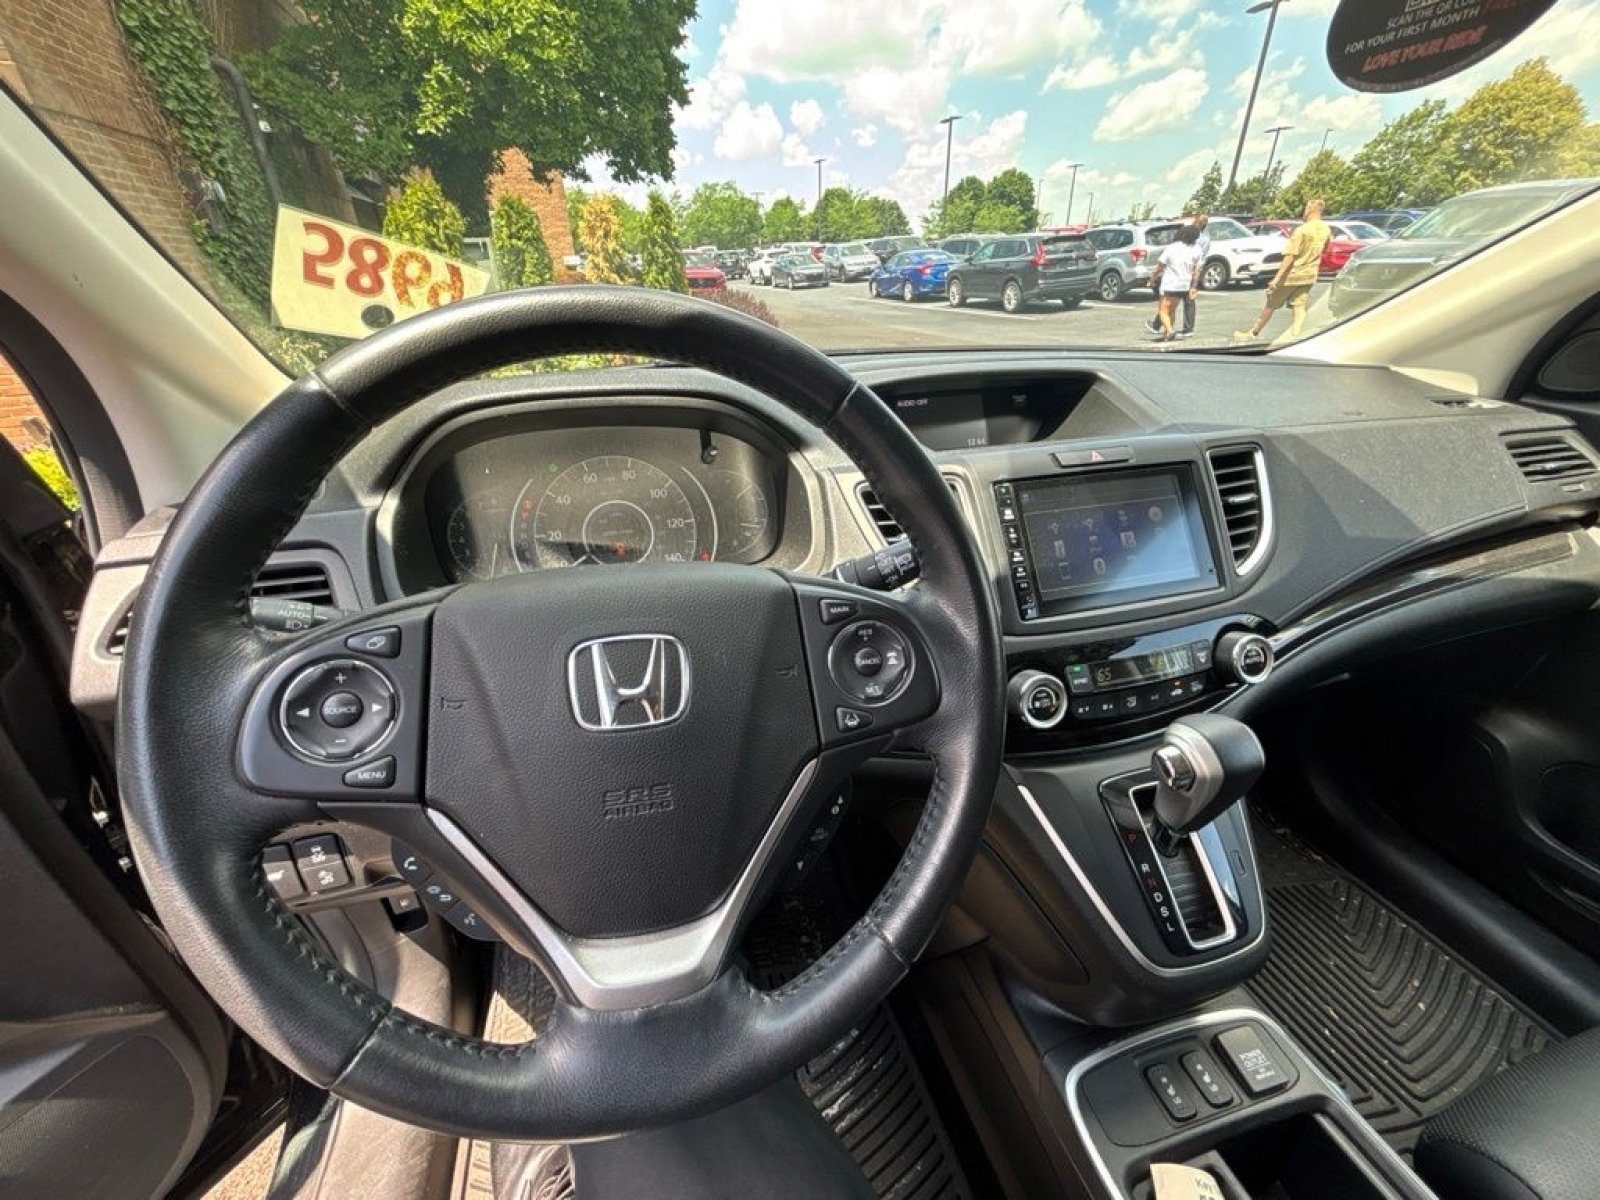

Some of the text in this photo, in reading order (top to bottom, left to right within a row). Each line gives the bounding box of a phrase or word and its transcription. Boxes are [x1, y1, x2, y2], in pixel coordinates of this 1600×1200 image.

[1344, 40, 1365, 55] FOR
[1366, 32, 1397, 49] YOUR
[1396, 20, 1428, 42] FIRST
[1430, 7, 1482, 29] MONTH
[1362, 52, 1398, 73] LOVE
[1400, 40, 1442, 64] YOUR
[582, 472, 599, 484] 60
[622, 469, 637, 481] 80
[554, 494, 572, 506] 40
[650, 488, 668, 500] 100
[665, 517, 685, 530] 120
[547, 529, 563, 542] 20
[663, 551, 683, 563] 140
[323, 705, 358, 716] SOURCE
[357, 769, 387, 780] MENU
[603, 784, 671, 803] SRS
[1141, 863, 1151, 873] R
[1153, 892, 1164, 902] D
[1160, 906, 1170, 918] S
[1166, 922, 1176, 932] L
